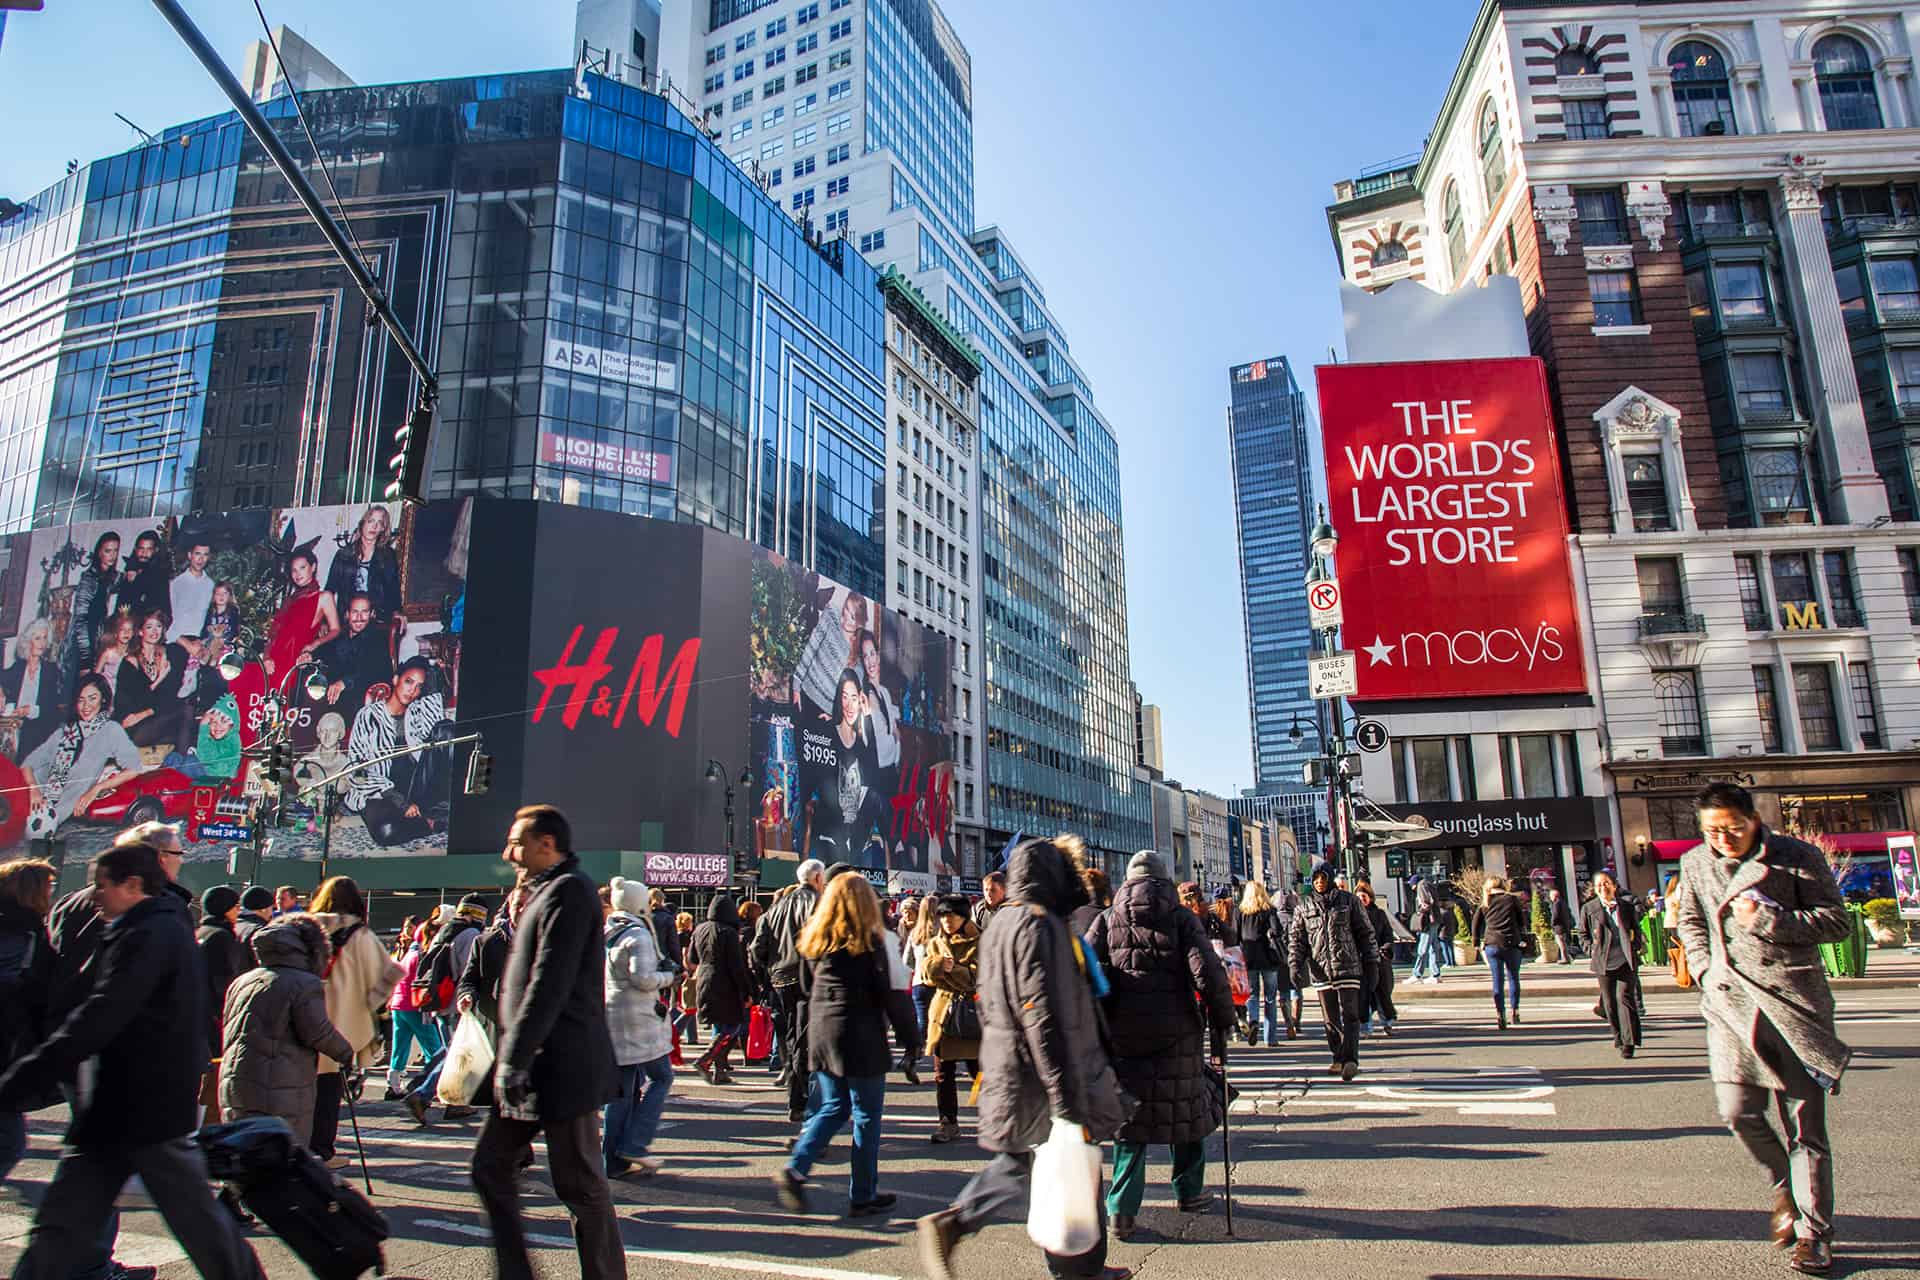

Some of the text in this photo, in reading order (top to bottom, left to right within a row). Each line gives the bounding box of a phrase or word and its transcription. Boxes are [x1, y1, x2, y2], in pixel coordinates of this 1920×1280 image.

[555, 347, 598, 369] ASA
[604, 353, 621, 364] The
[623, 357, 656, 370] College
[603, 365, 651, 381] Excelence
[1392, 400, 1477, 435] THE
[555, 436, 658, 467] MODELL'S
[1344, 439, 1536, 480] WORLD'S
[555, 452, 657, 479] SPORTING GOODS
[1352, 481, 1534, 523] LARGEST
[1386, 526, 1519, 566] STORE
[1782, 602, 1822, 631] M
[1401, 621, 1564, 671] macy's
[1318, 659, 1346, 671] BUSES
[1321, 670, 1344, 680] ONLY
[532, 624, 702, 739] H&M
[249, 693, 288, 707] Drs
[803, 728, 832, 746] Sweater
[803, 742, 837, 767] $19.95
[202, 827, 222, 837] West
[239, 829, 247, 839] St
[1433, 811, 1549, 838] sunglass hut
[646, 855, 727, 872] ASA COLLEGE
[649, 871, 725, 884] WWW.ASA.EDU
